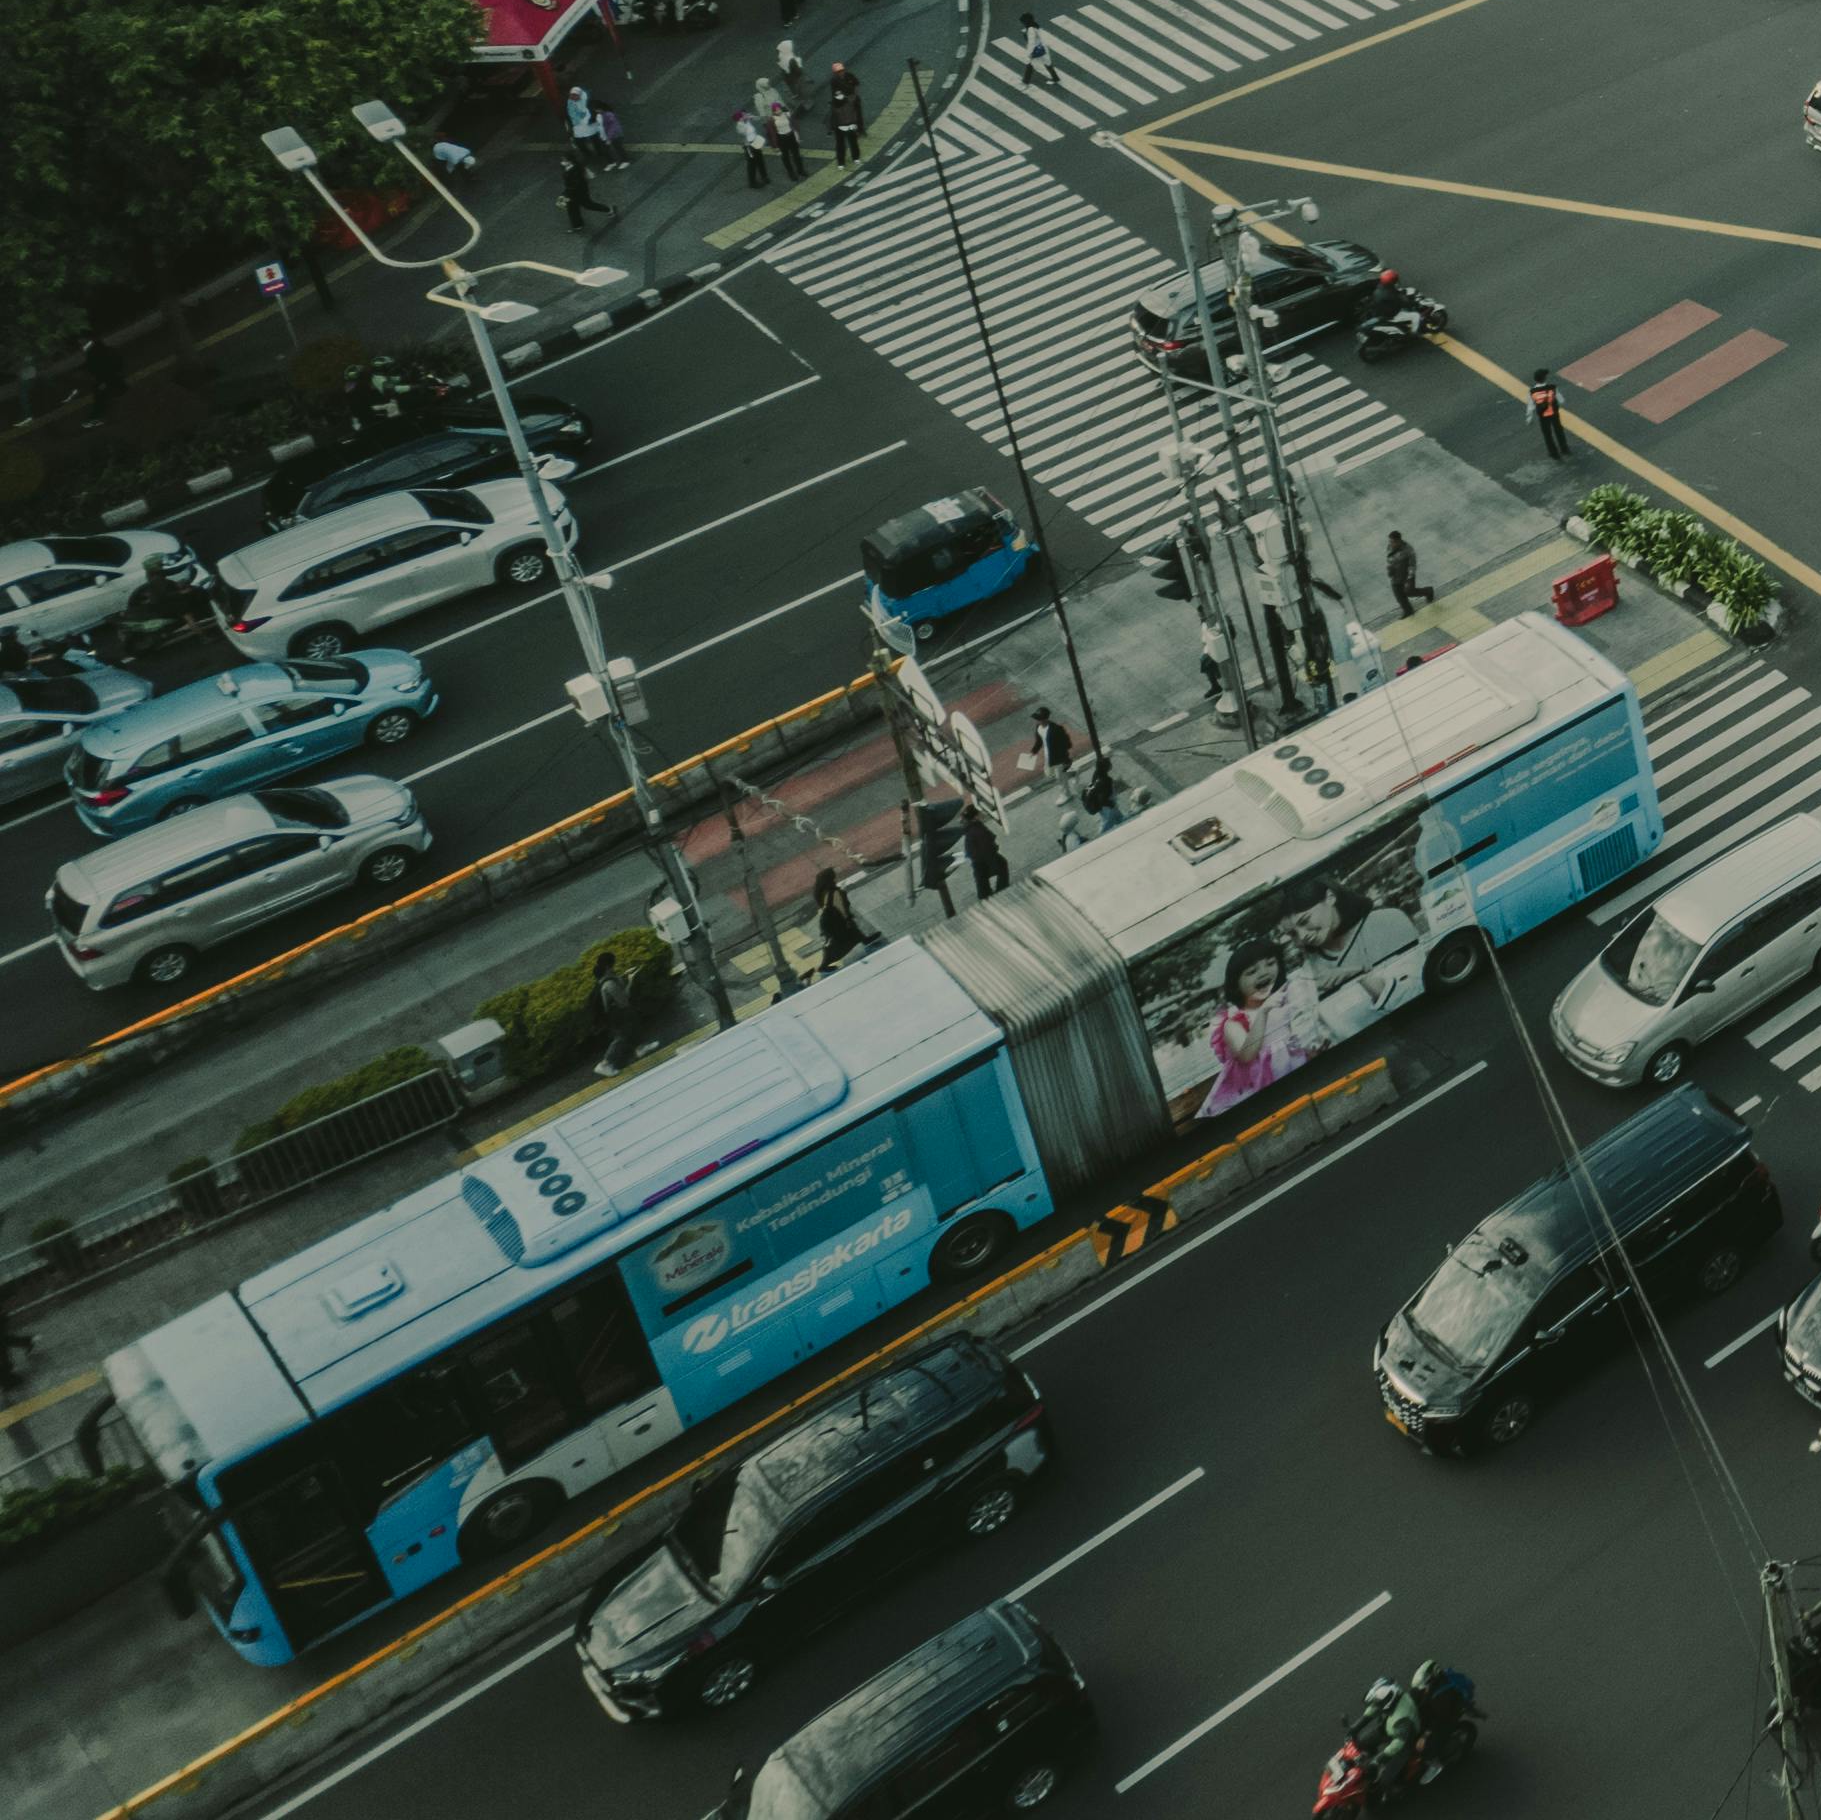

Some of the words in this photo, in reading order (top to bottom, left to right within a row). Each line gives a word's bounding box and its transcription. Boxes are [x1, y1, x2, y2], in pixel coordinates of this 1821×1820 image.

[735, 1178, 823, 1234] Kebaikan
[826, 1137, 895, 1183] Mineral
[767, 1166, 873, 1233] Terlindungi
[665, 1243, 725, 1282] Minerale
[682, 1249, 701, 1263] Le
[729, 1208, 913, 1327] transjakarta
